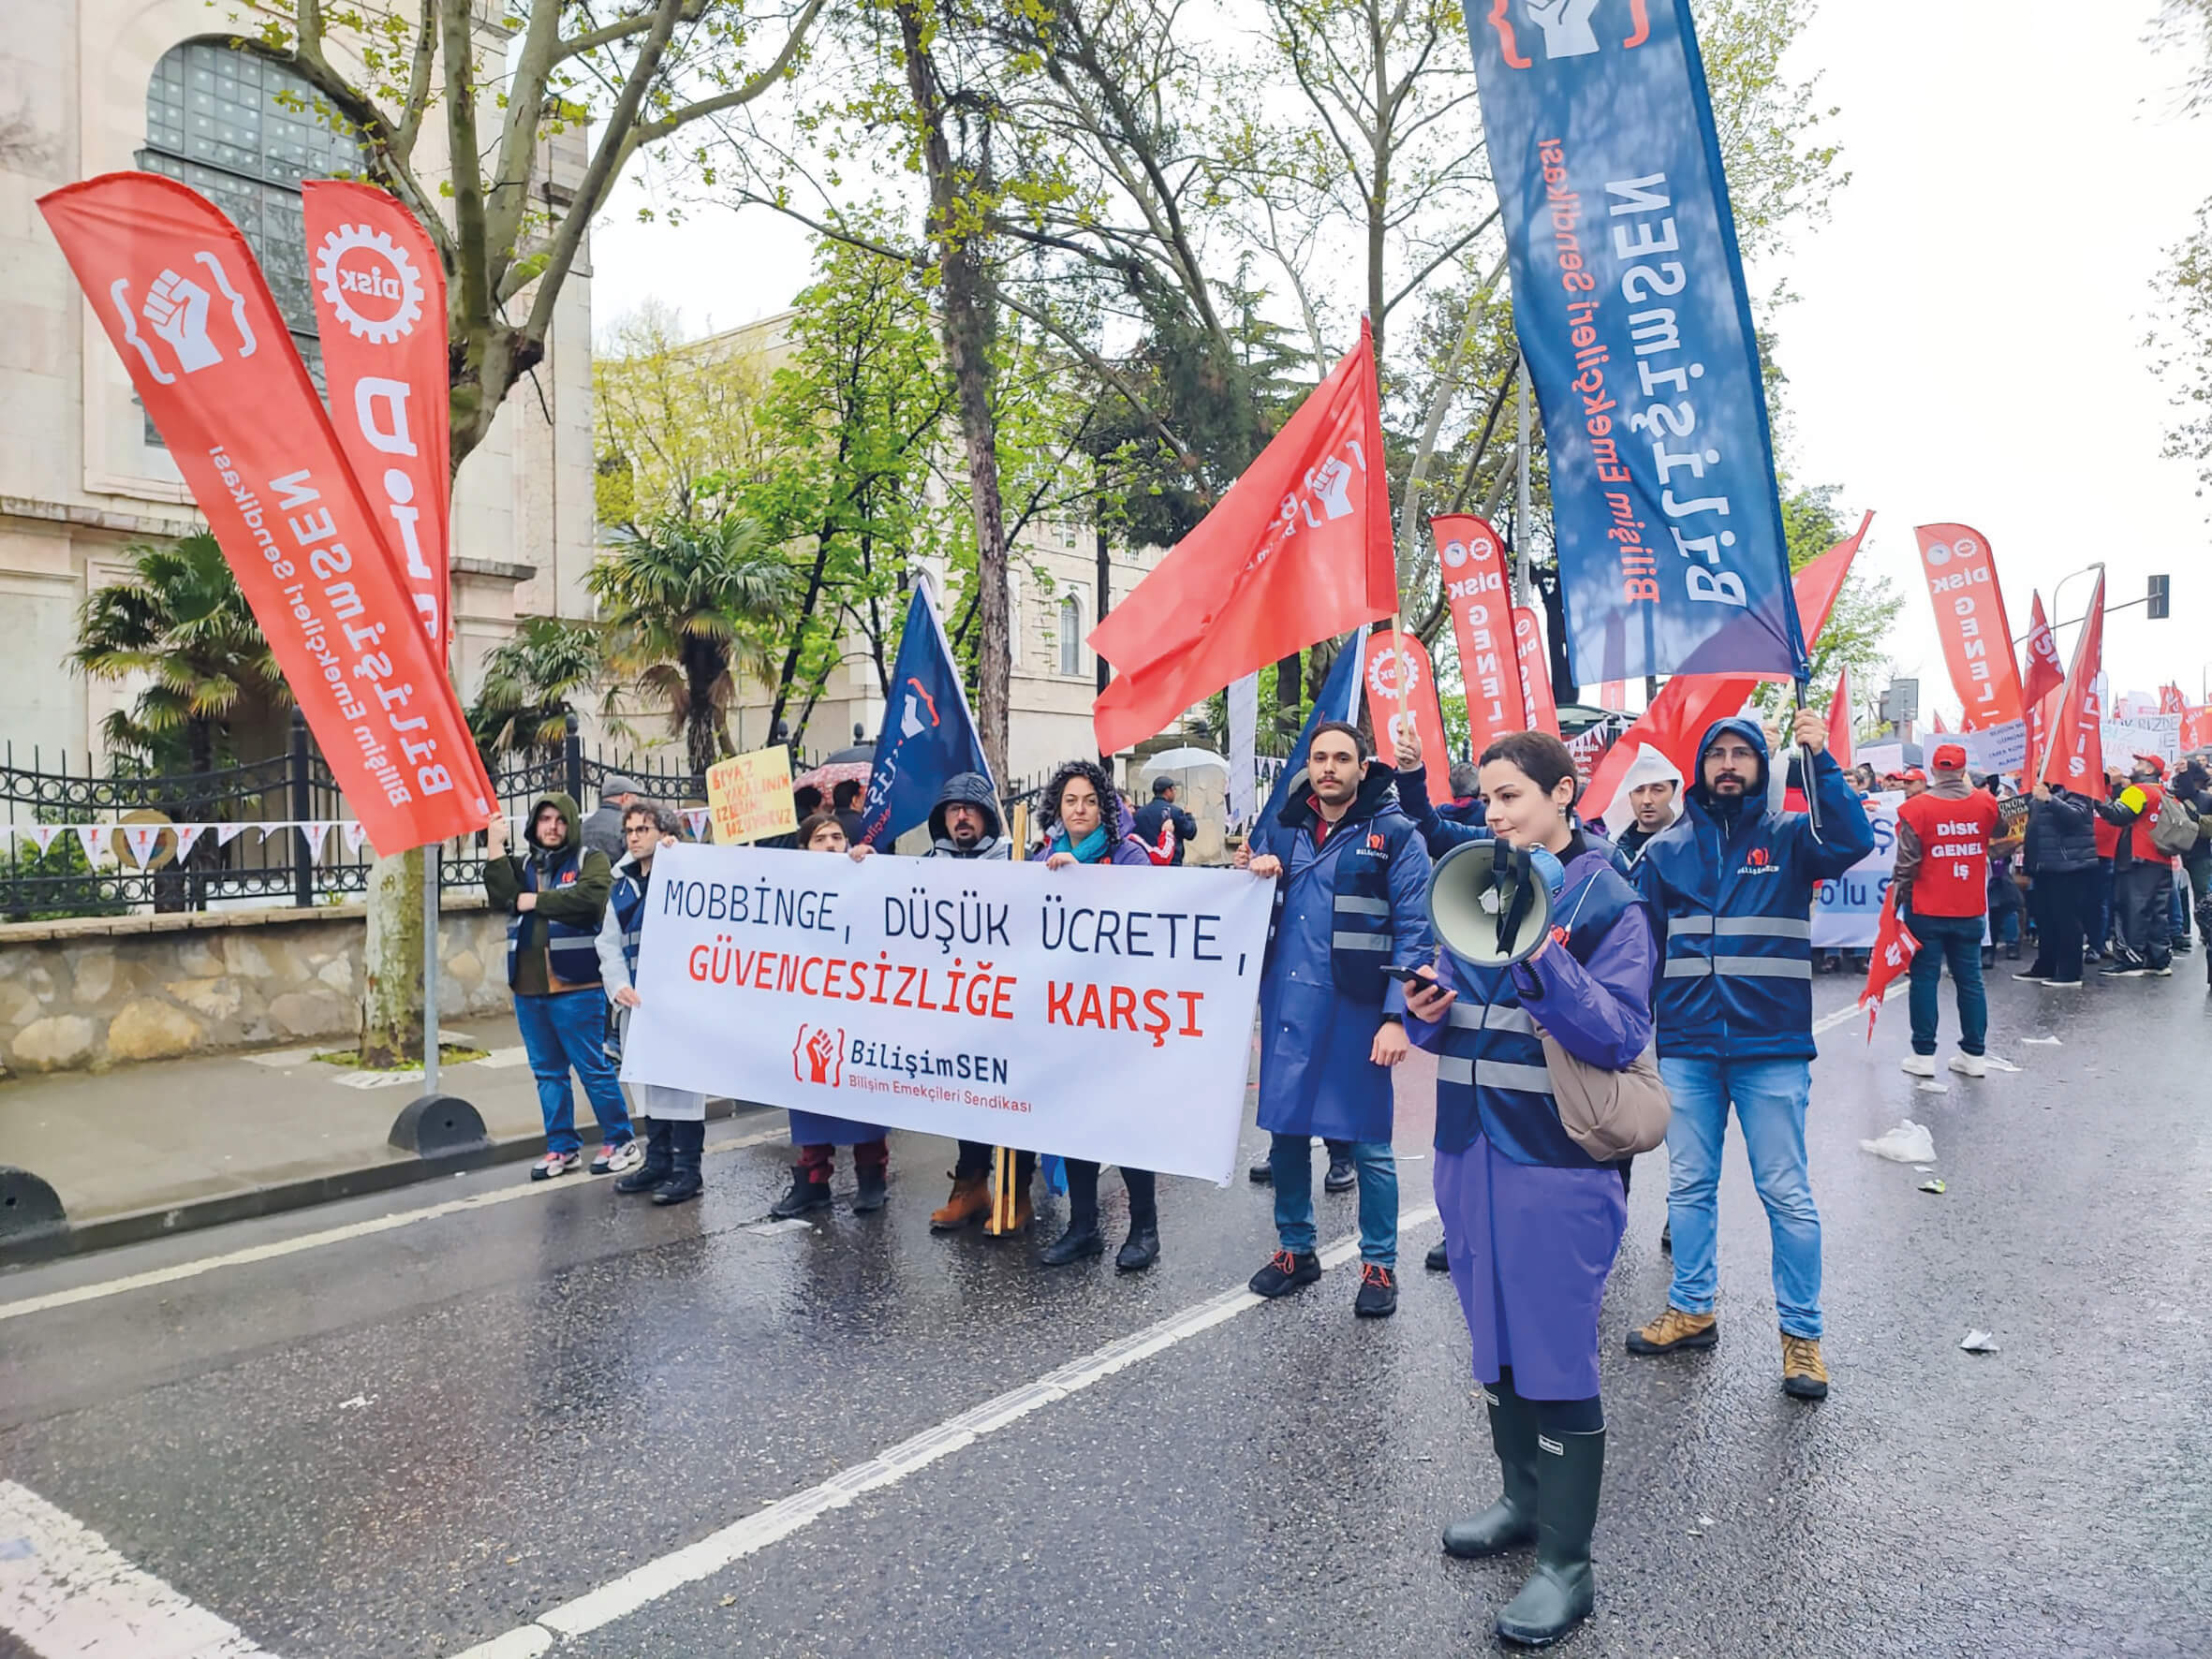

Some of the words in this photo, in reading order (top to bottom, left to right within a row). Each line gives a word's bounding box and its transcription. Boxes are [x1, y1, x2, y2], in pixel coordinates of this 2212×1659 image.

[1936, 819, 1981, 836] DİSK
[1931, 842, 1983, 859] GENEL
[1953, 860, 1970, 881] İŞ
[663, 876, 850, 945] MOBBİNGE,
[884, 887, 1010, 955] DÜŞÜK
[1041, 894, 1246, 976] ÜCRETE,
[688, 933, 1018, 1020] GÜVENCESİZLİĞE
[1047, 980, 1204, 1048] KARŞI
[850, 1039, 1009, 1086] BilişimSEN
[848, 1074, 890, 1094] Bilişim
[892, 1080, 961, 1104] Emekçileri
[964, 1090, 1032, 1113] Sendikası
